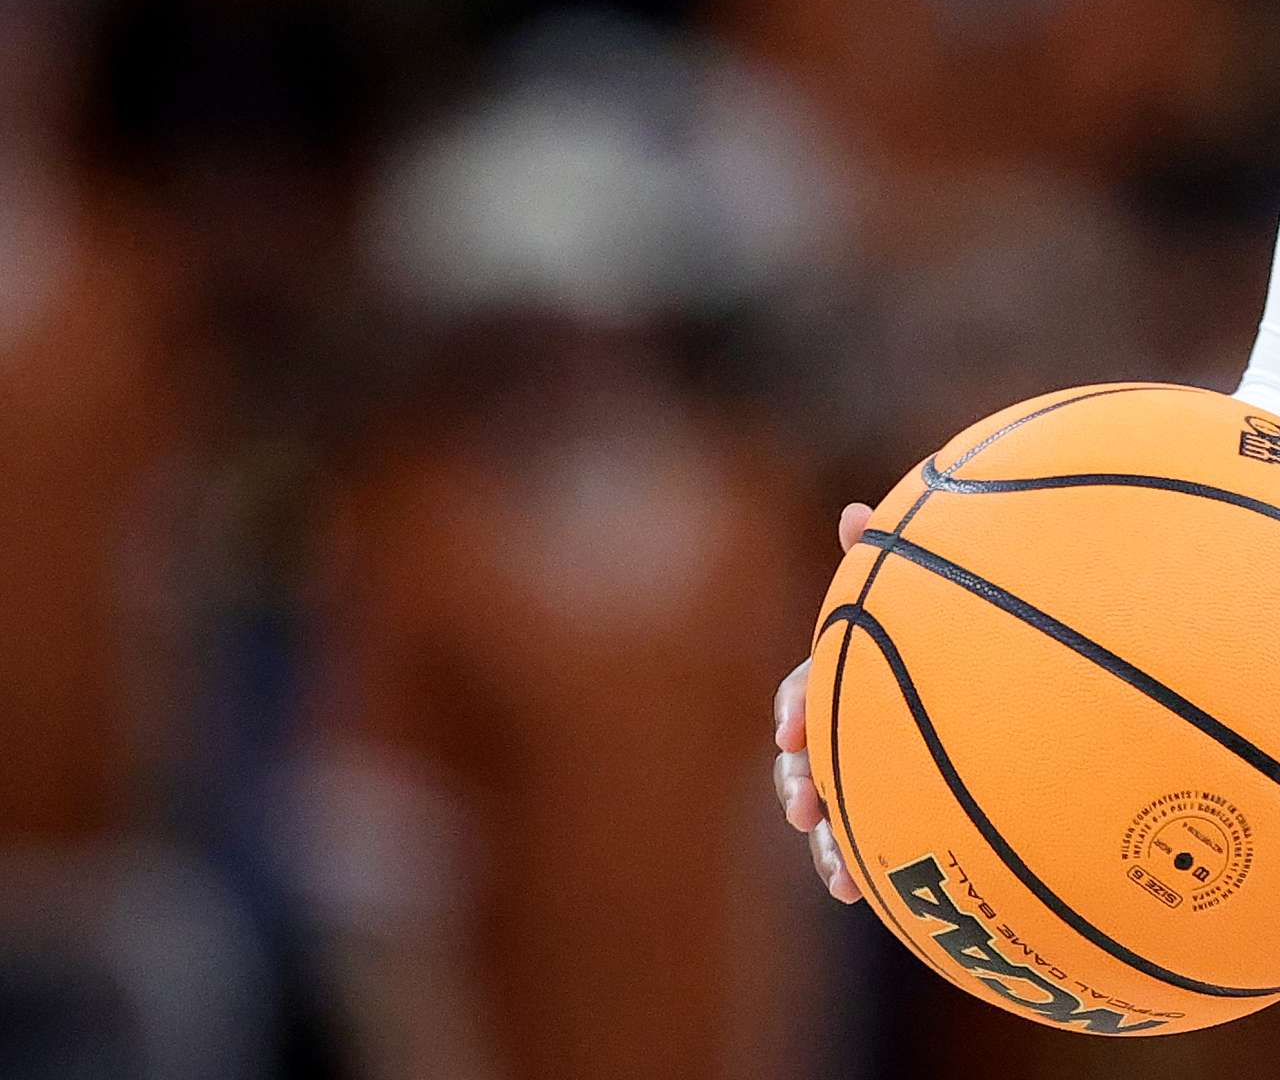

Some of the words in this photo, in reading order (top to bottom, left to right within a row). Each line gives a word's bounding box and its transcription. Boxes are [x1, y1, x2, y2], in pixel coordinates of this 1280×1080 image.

[948, 849, 997, 919] BALL
[1132, 869, 1144, 880] 6
[1145, 879, 1177, 904] SIZE
[887, 853, 1170, 1034] NCAA
[996, 923, 1068, 980] GAME
[1073, 980, 1186, 1019] OFFICIAL
